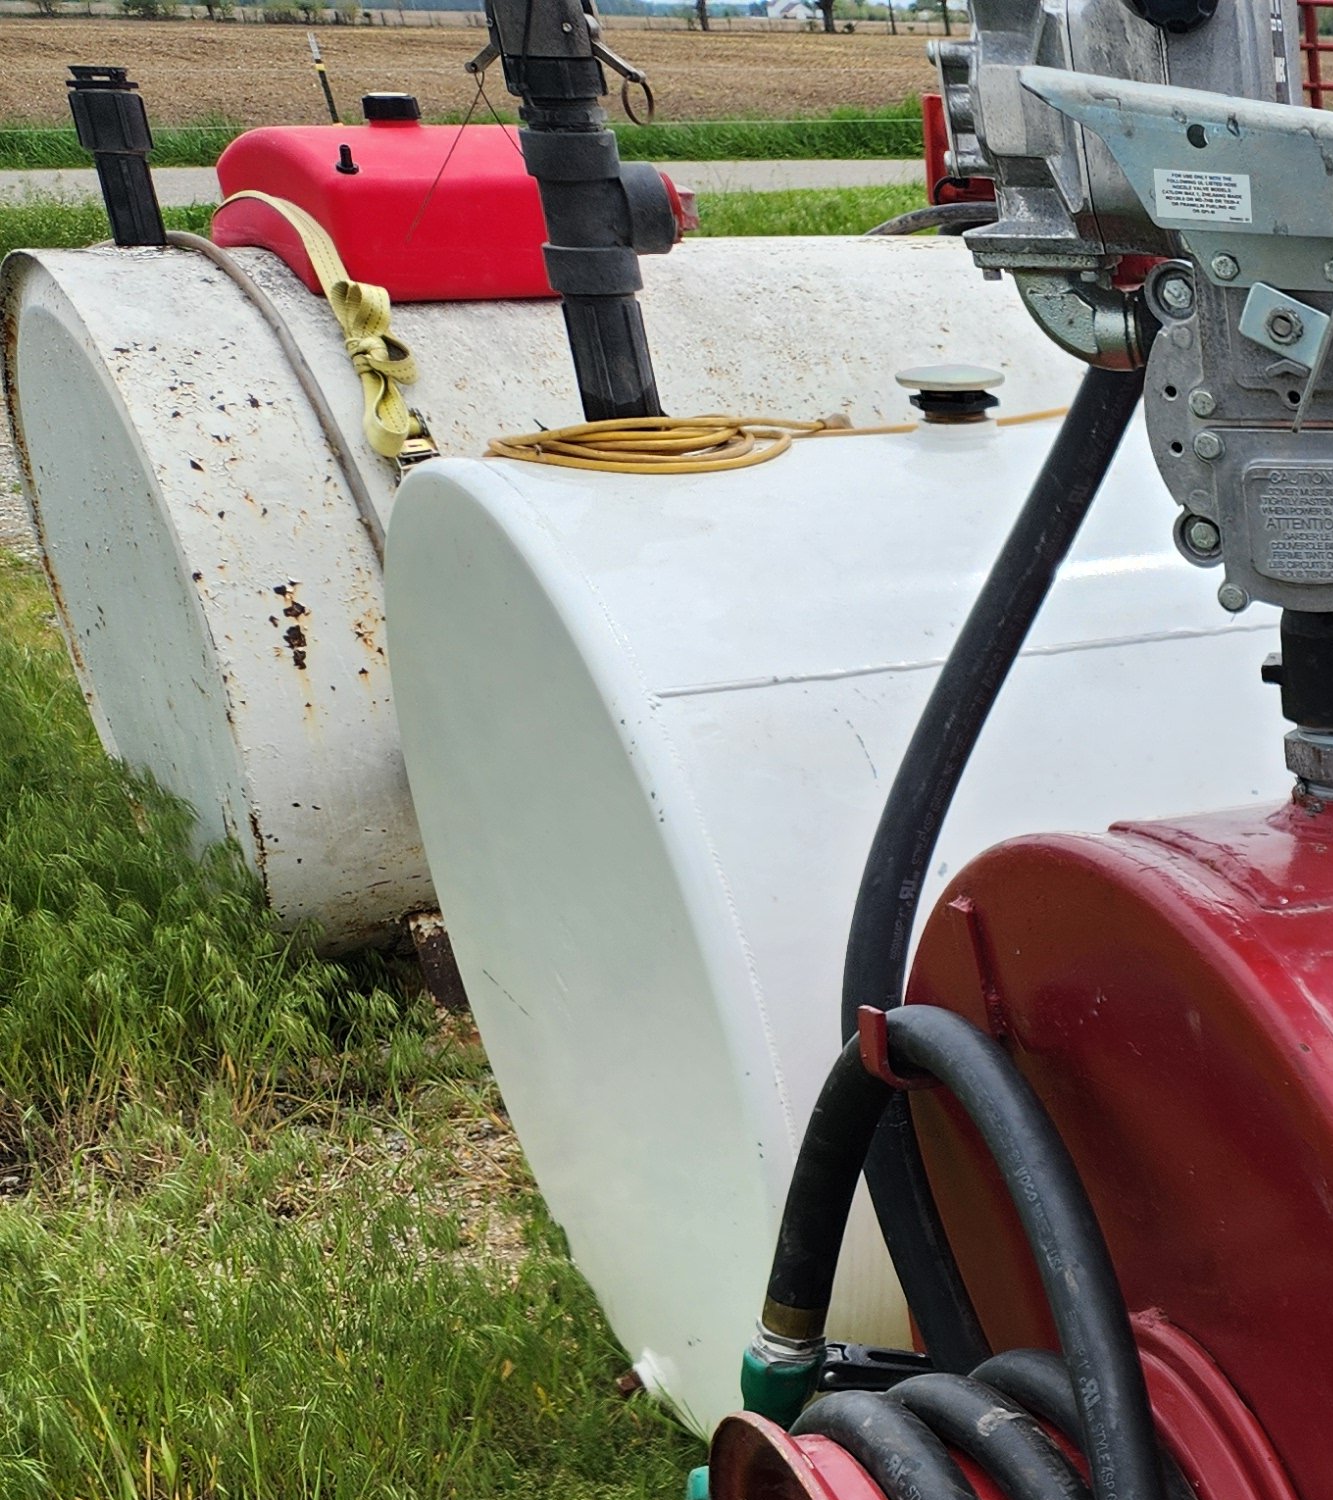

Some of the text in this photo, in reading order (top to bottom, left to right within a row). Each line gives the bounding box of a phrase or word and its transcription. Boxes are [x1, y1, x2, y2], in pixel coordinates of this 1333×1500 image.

[1299, 486, 1325, 497] MUST
[1261, 495, 1299, 506] TIGHTLY
[1260, 505, 1289, 516] WHEN
[1289, 506, 1322, 517] POWER
[1270, 541, 1325, 551] COUVERCLE
[1303, 551, 1326, 561] TANT
[1268, 560, 1286, 570] LES
[1286, 560, 1326, 571] CIRCUITS
[1090, 1421, 1112, 1465] STYLE
